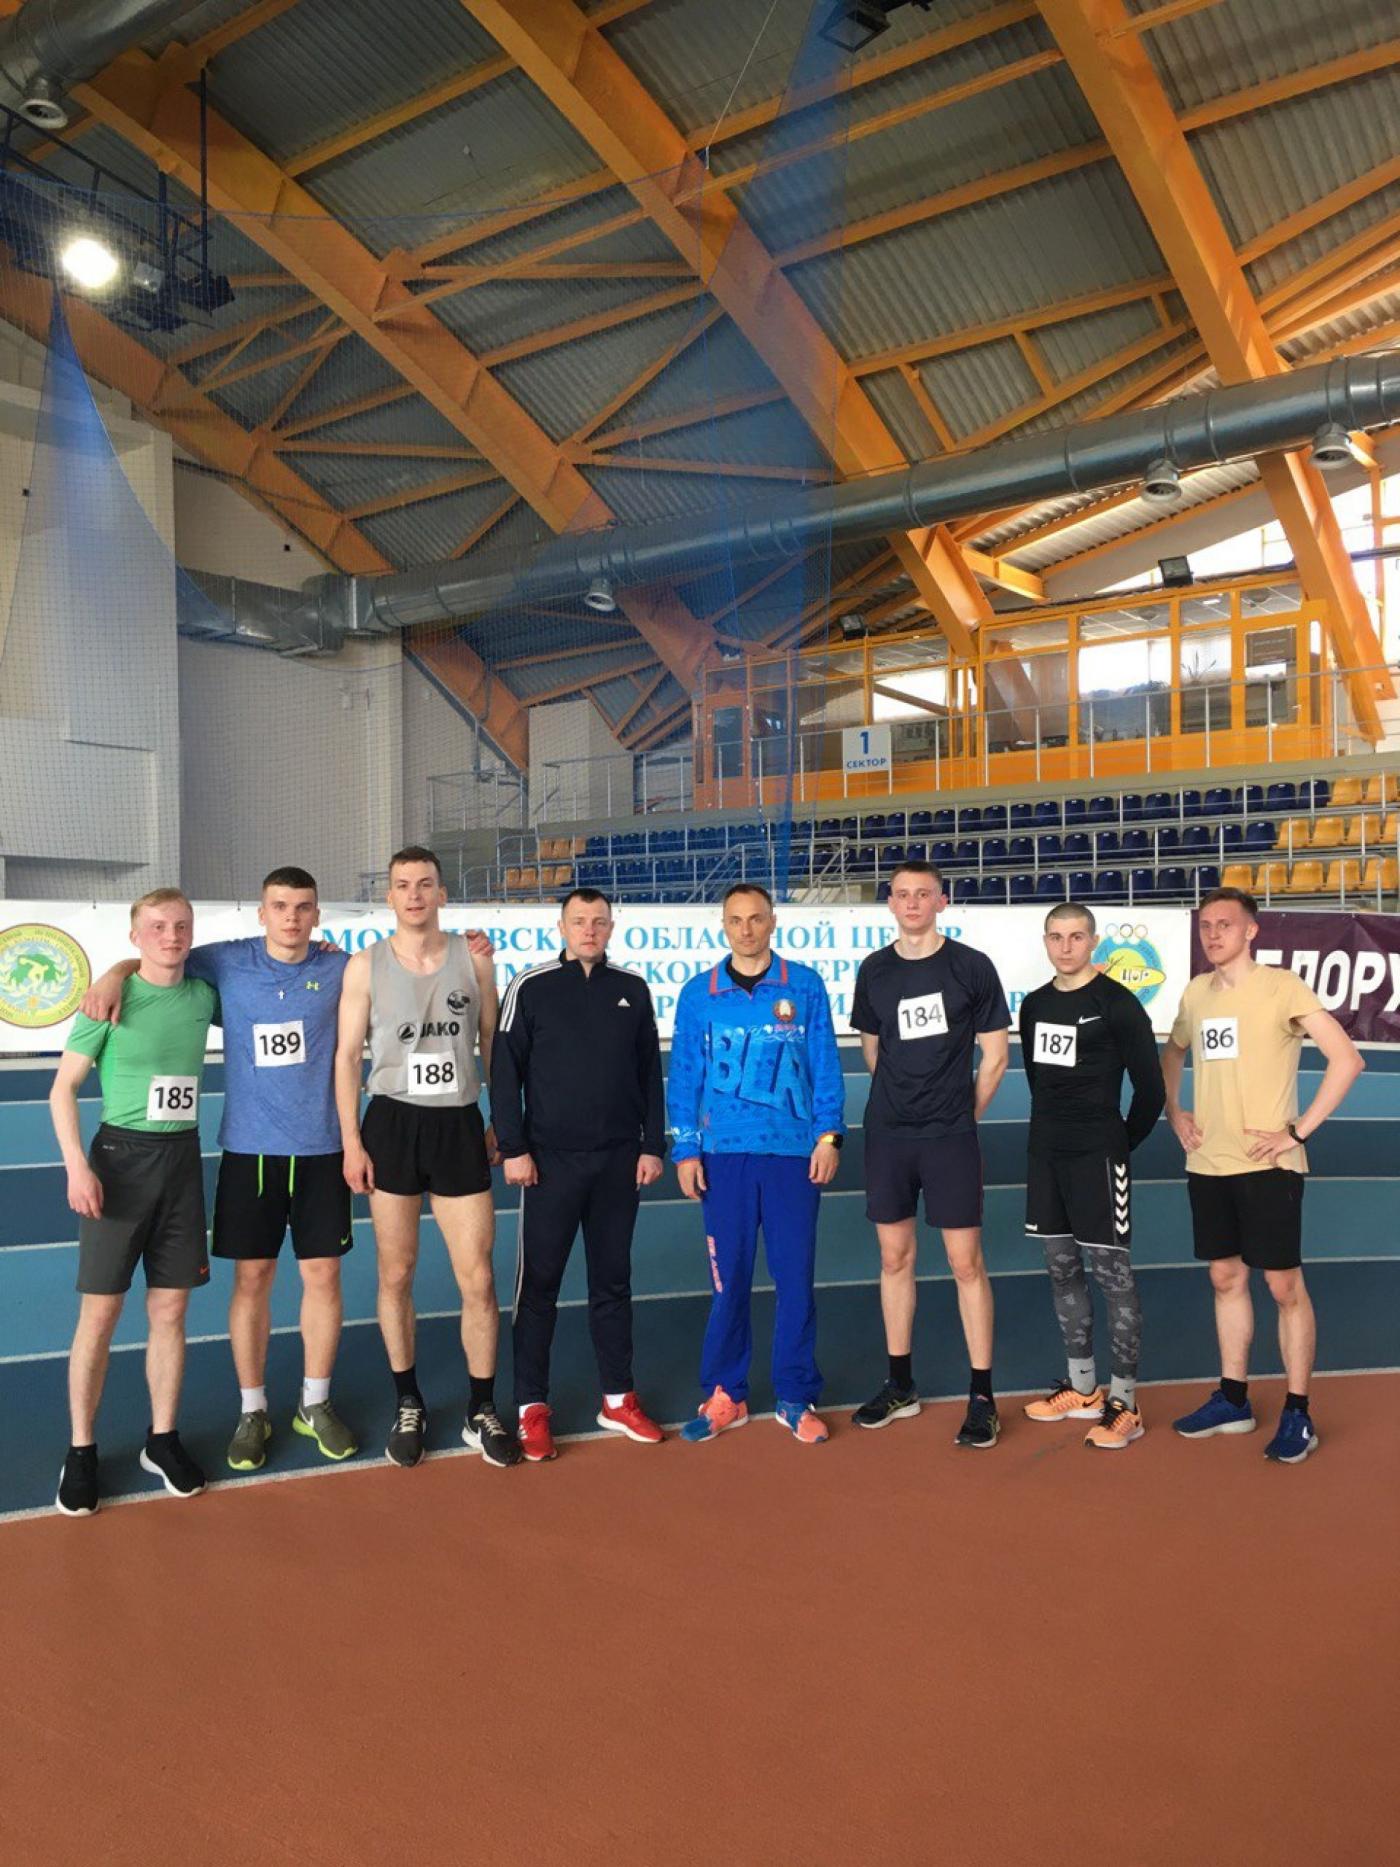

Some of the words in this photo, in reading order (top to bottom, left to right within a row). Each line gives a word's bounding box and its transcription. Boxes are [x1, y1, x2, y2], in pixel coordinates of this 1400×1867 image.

[860, 731, 869, 755] 1
[846, 757, 887, 769] СЕКТОР
[901, 1003, 943, 1029] 184
[420, 1021, 460, 1038] JAKO
[259, 1031, 302, 1056] 189
[1040, 1032, 1074, 1056] 187
[412, 1061, 455, 1085] 188
[154, 1086, 194, 1110] 185
